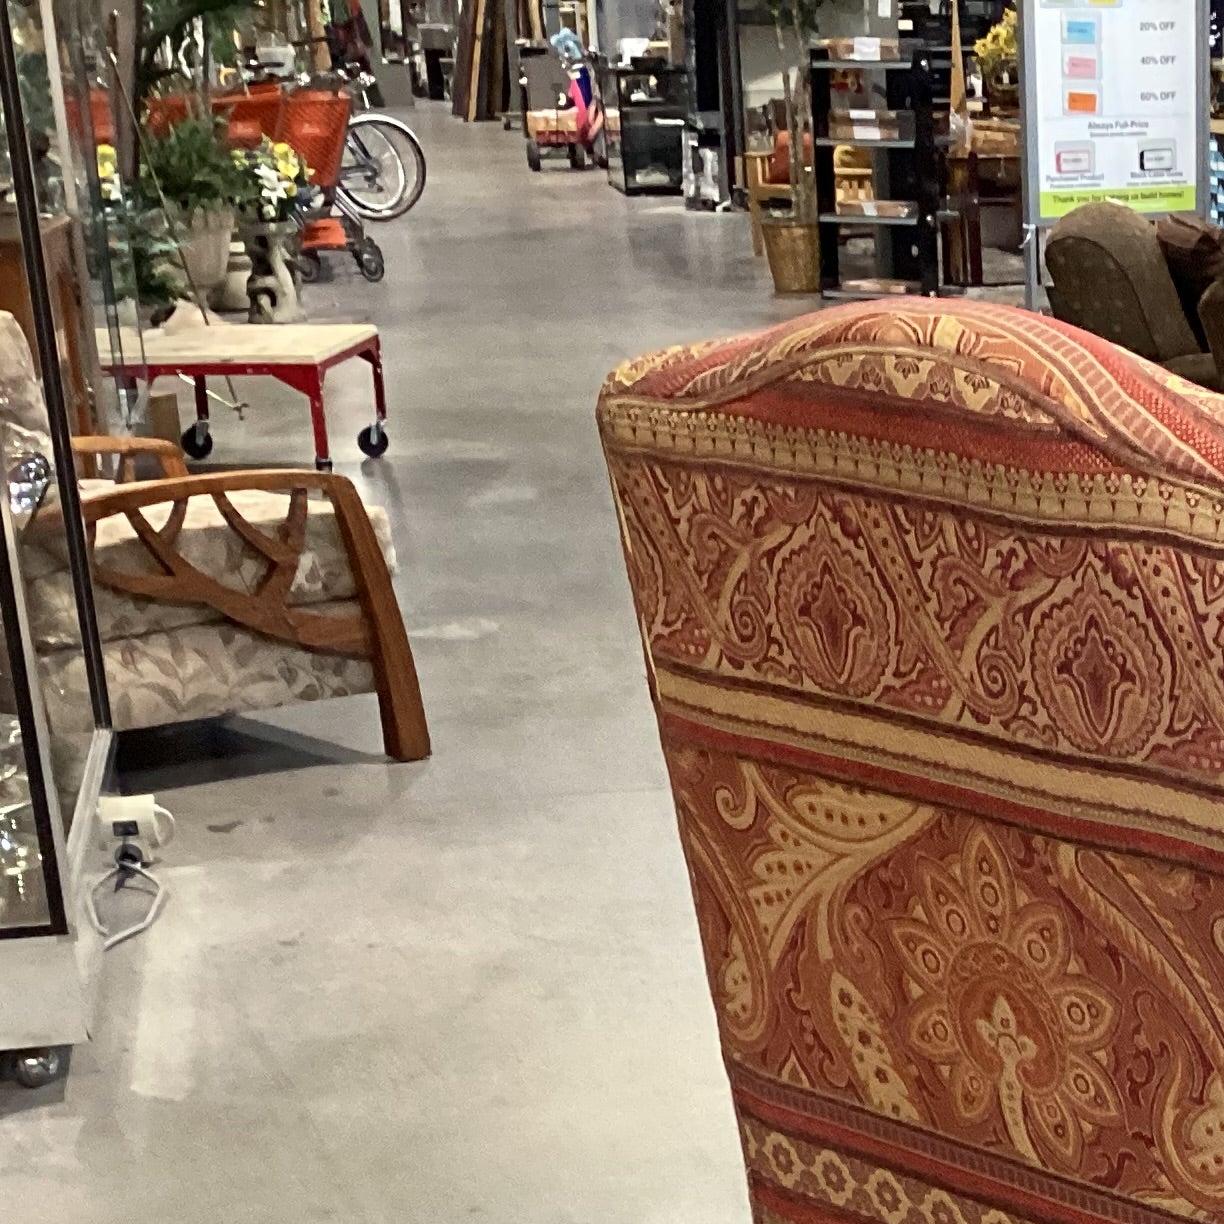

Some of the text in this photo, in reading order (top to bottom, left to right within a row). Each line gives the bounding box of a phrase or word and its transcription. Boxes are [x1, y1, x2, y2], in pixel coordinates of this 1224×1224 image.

[1139, 21, 1175, 31] 20% OFF
[1140, 55, 1176, 65] 40% OFF
[1160, 91, 1176, 101] OFF
[1088, 121, 1114, 131] Always
